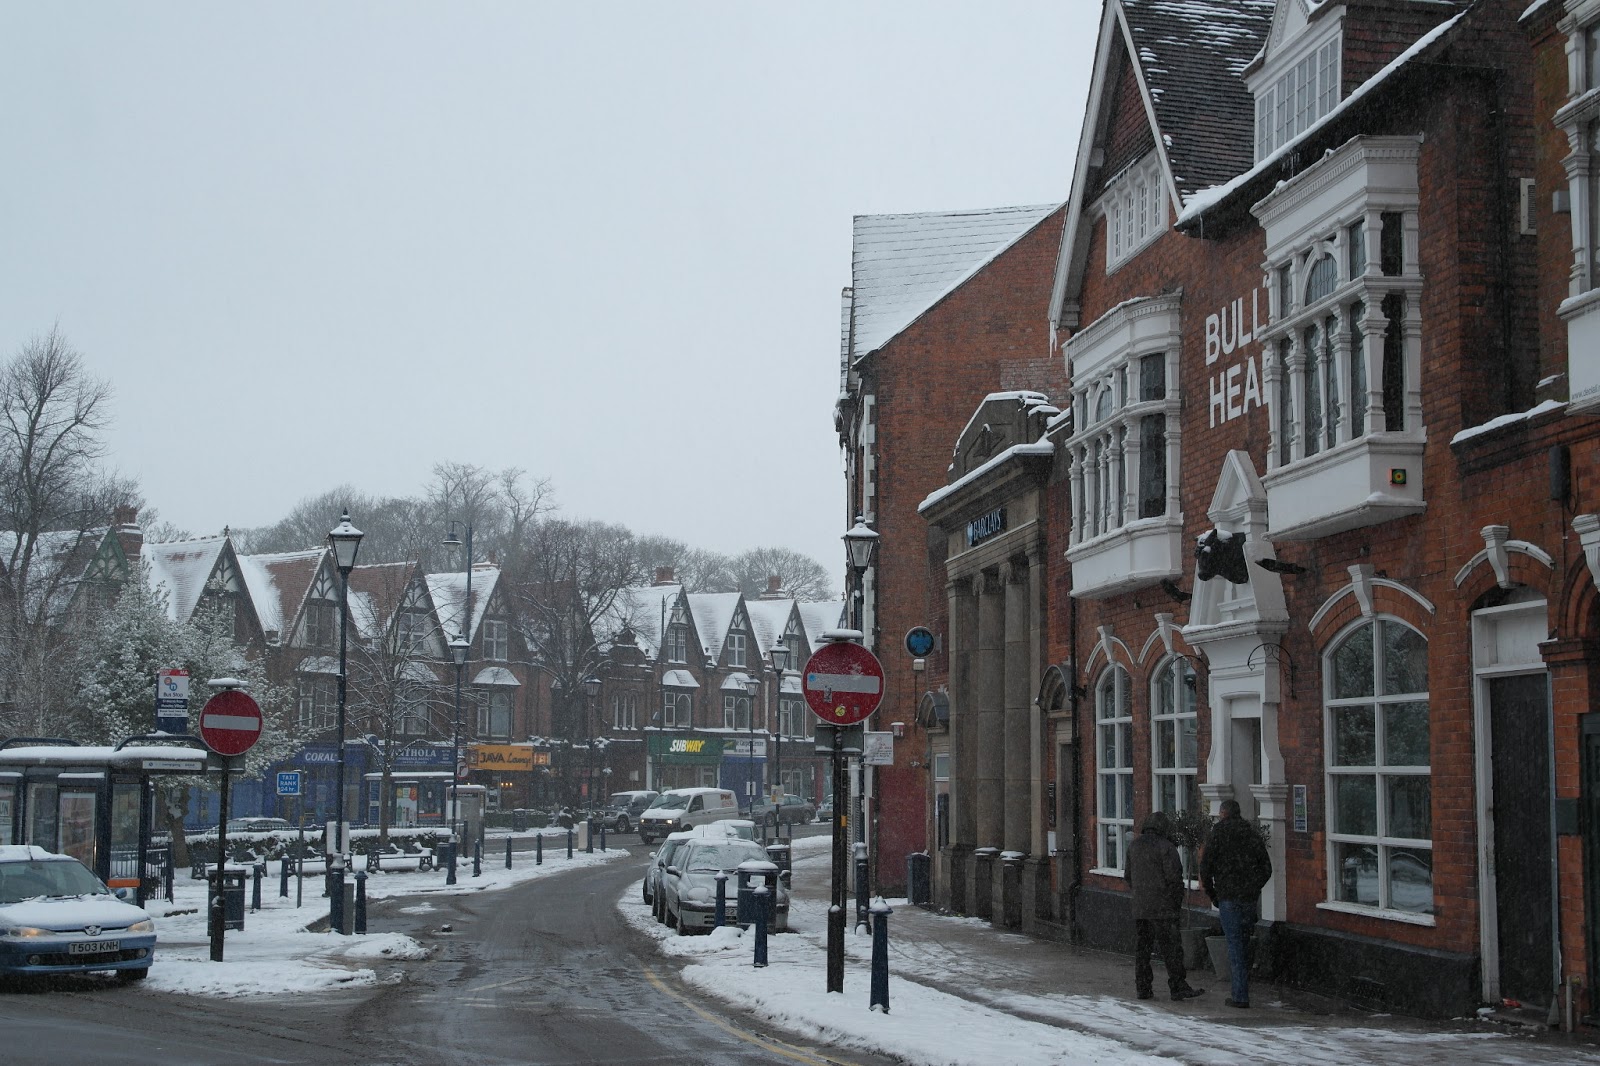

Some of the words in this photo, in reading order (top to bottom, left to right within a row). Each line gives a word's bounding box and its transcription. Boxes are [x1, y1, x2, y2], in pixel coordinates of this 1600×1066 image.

[973, 508, 1001, 541] BARCLAYS
[670, 740, 705, 752] SUBWAY
[305, 752, 335, 762] CORAL
[480, 752, 505, 763] JAVA
[71, 943, 98, 952] T503
[100, 941, 118, 952] KNH
